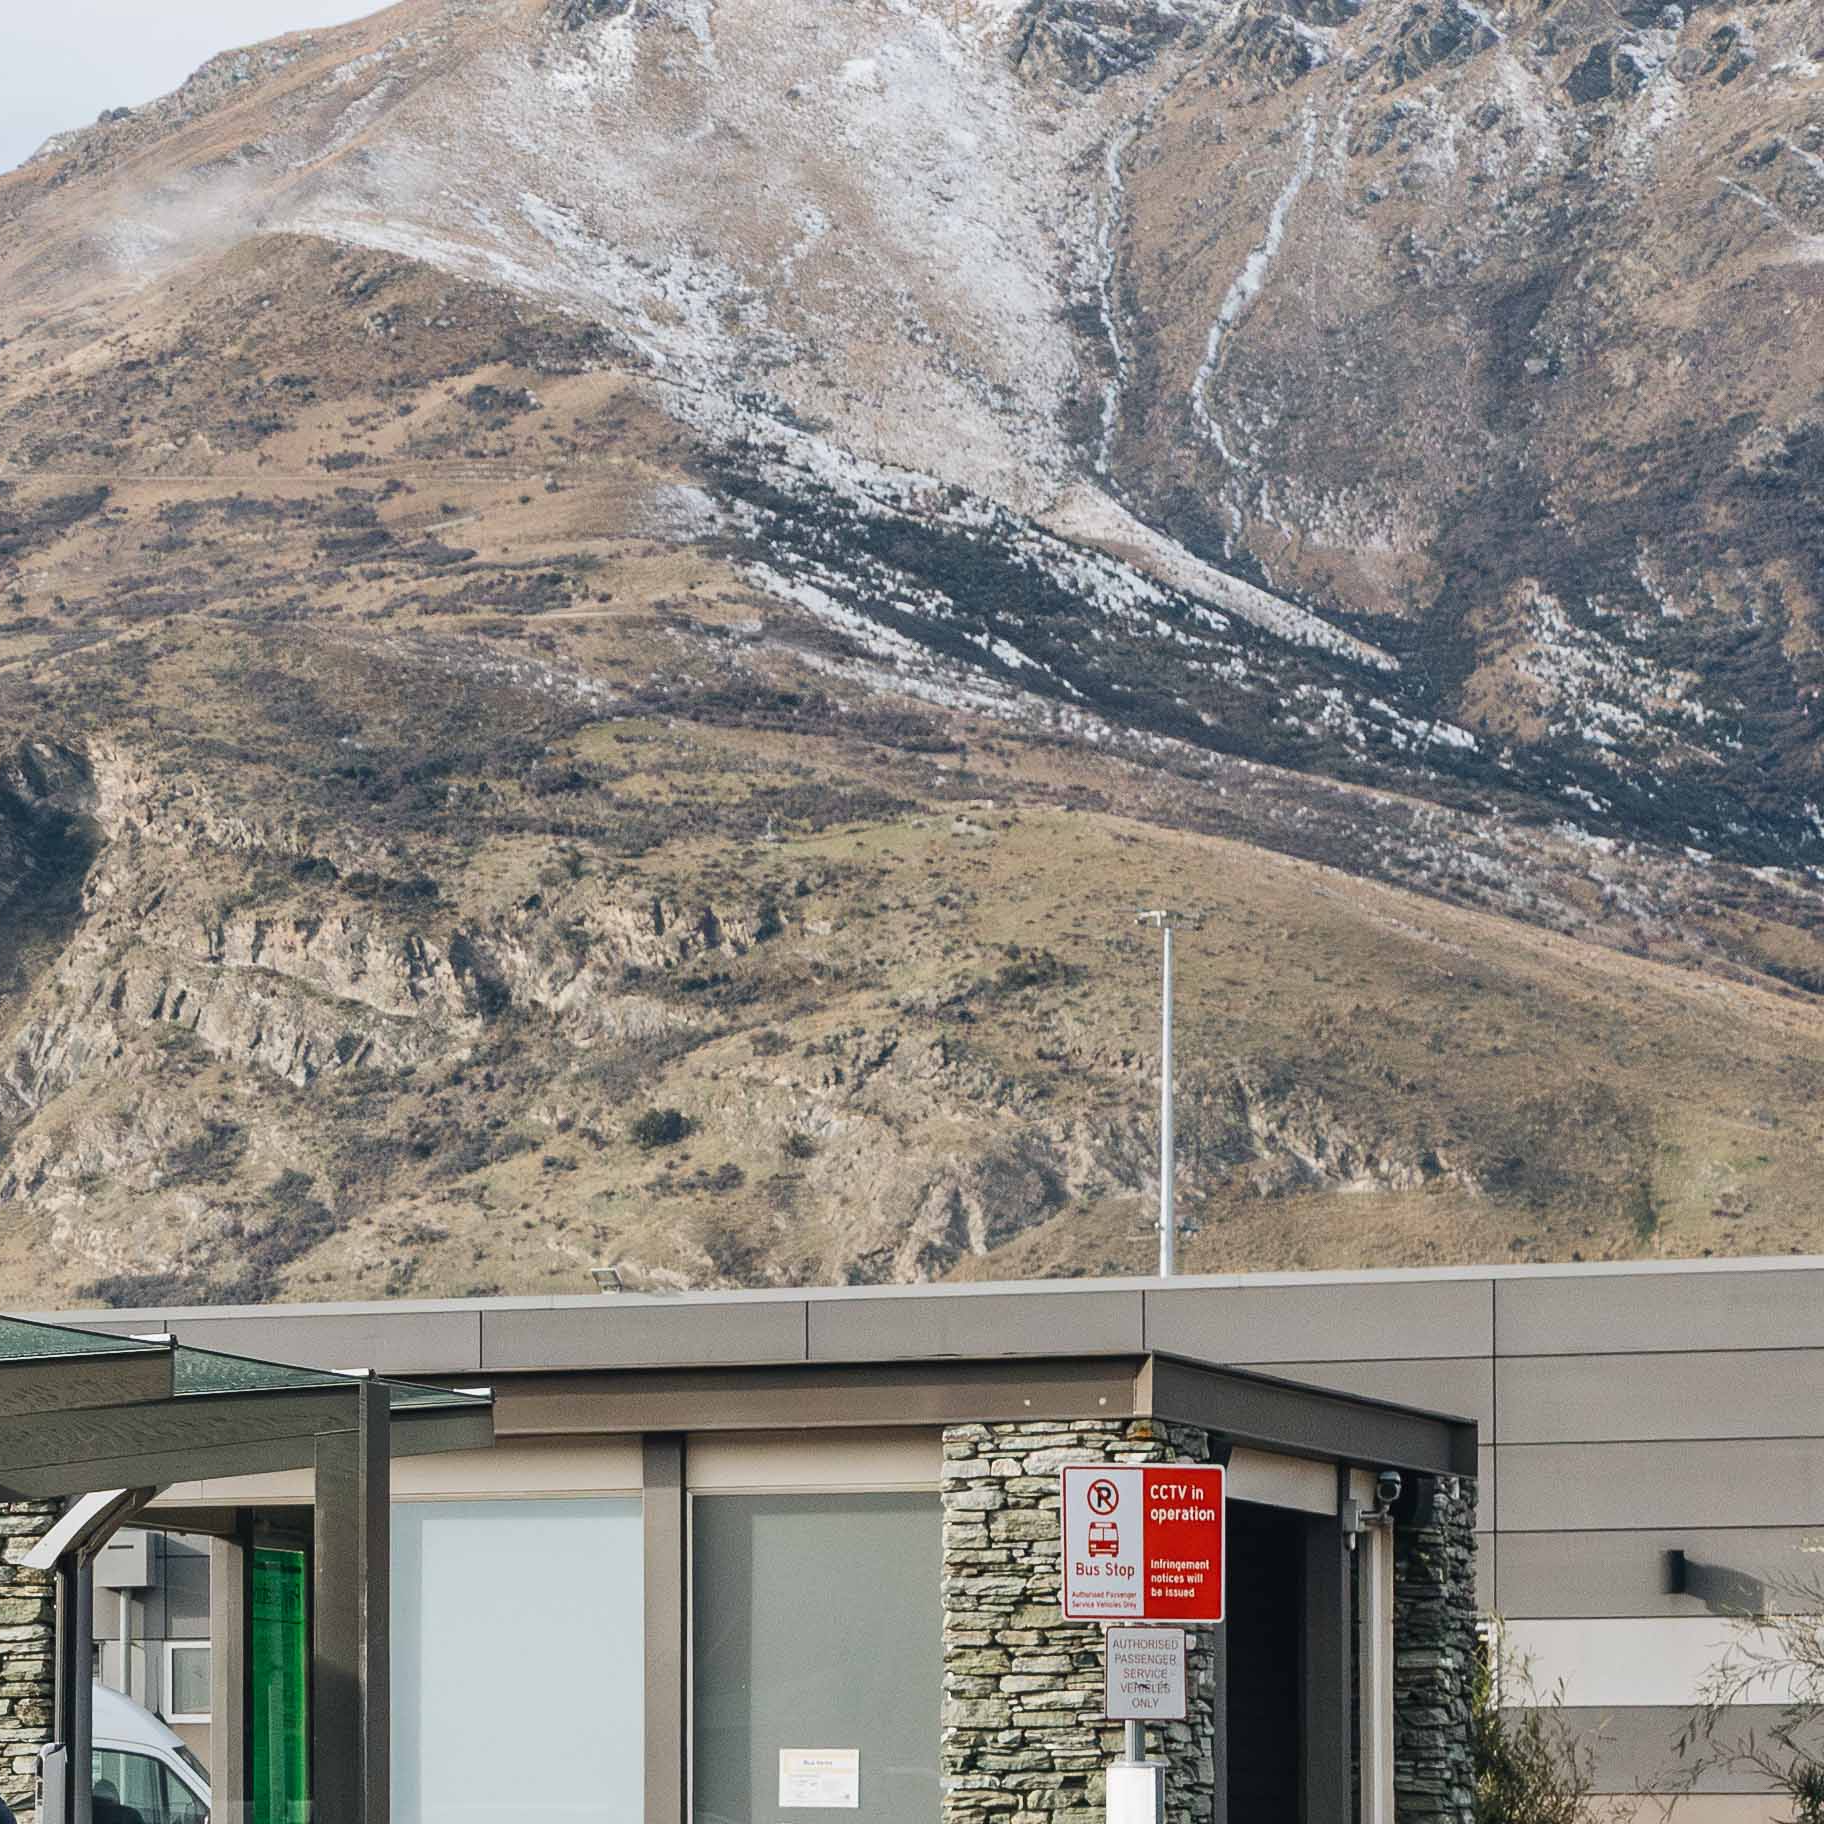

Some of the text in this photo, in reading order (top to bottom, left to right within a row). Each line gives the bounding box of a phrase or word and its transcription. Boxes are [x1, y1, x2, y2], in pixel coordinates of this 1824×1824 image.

[1150, 1485, 1204, 1500] CCTV in
[1150, 1506, 1215, 1524] operation
[1076, 1562, 1135, 1580] Bus Stop
[1150, 1559, 1209, 1572] Infringement
[1150, 1573, 1203, 1584] notices will
[1072, 1591, 1137, 1600] Authorised Passenger
[1150, 1587, 1195, 1598] be issued
[1072, 1601, 1137, 1610] Service Vehicles Only
[1112, 1639, 1179, 1650] AUTHORISED
[1114, 1654, 1177, 1665] PASSENGER
[1123, 1668, 1168, 1679] SERVICE
[1120, 1682, 1171, 1694] VEHICLES
[1131, 1697, 1160, 1708] ONLY
